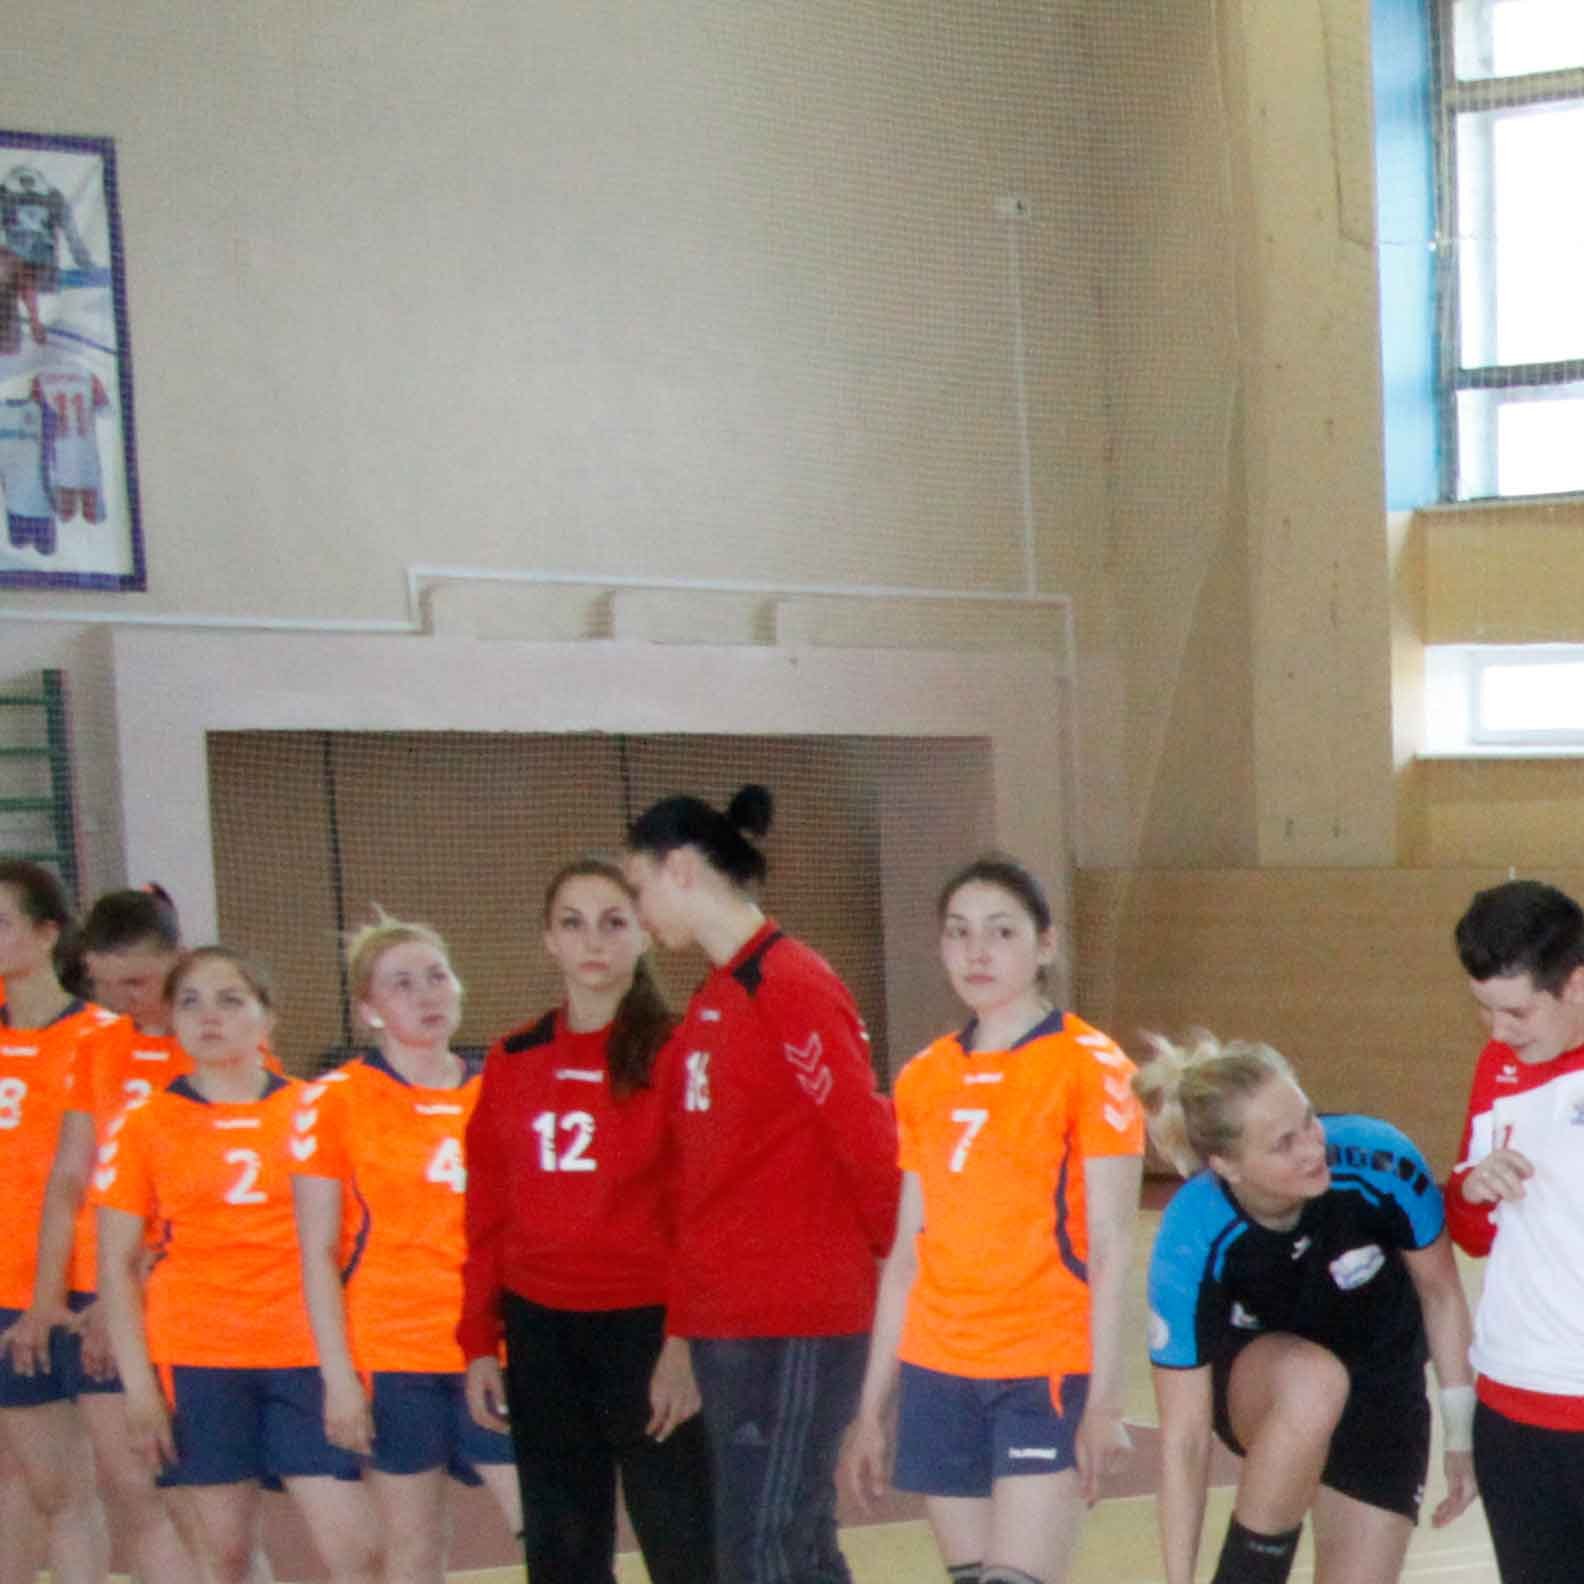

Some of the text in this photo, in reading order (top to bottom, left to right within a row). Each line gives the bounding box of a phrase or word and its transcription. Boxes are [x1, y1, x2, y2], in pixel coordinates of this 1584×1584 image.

[426, 1138, 467, 1193] 4
[532, 1111, 597, 1172] 12
[950, 1108, 988, 1173] 7
[223, 1148, 268, 1205] 2
